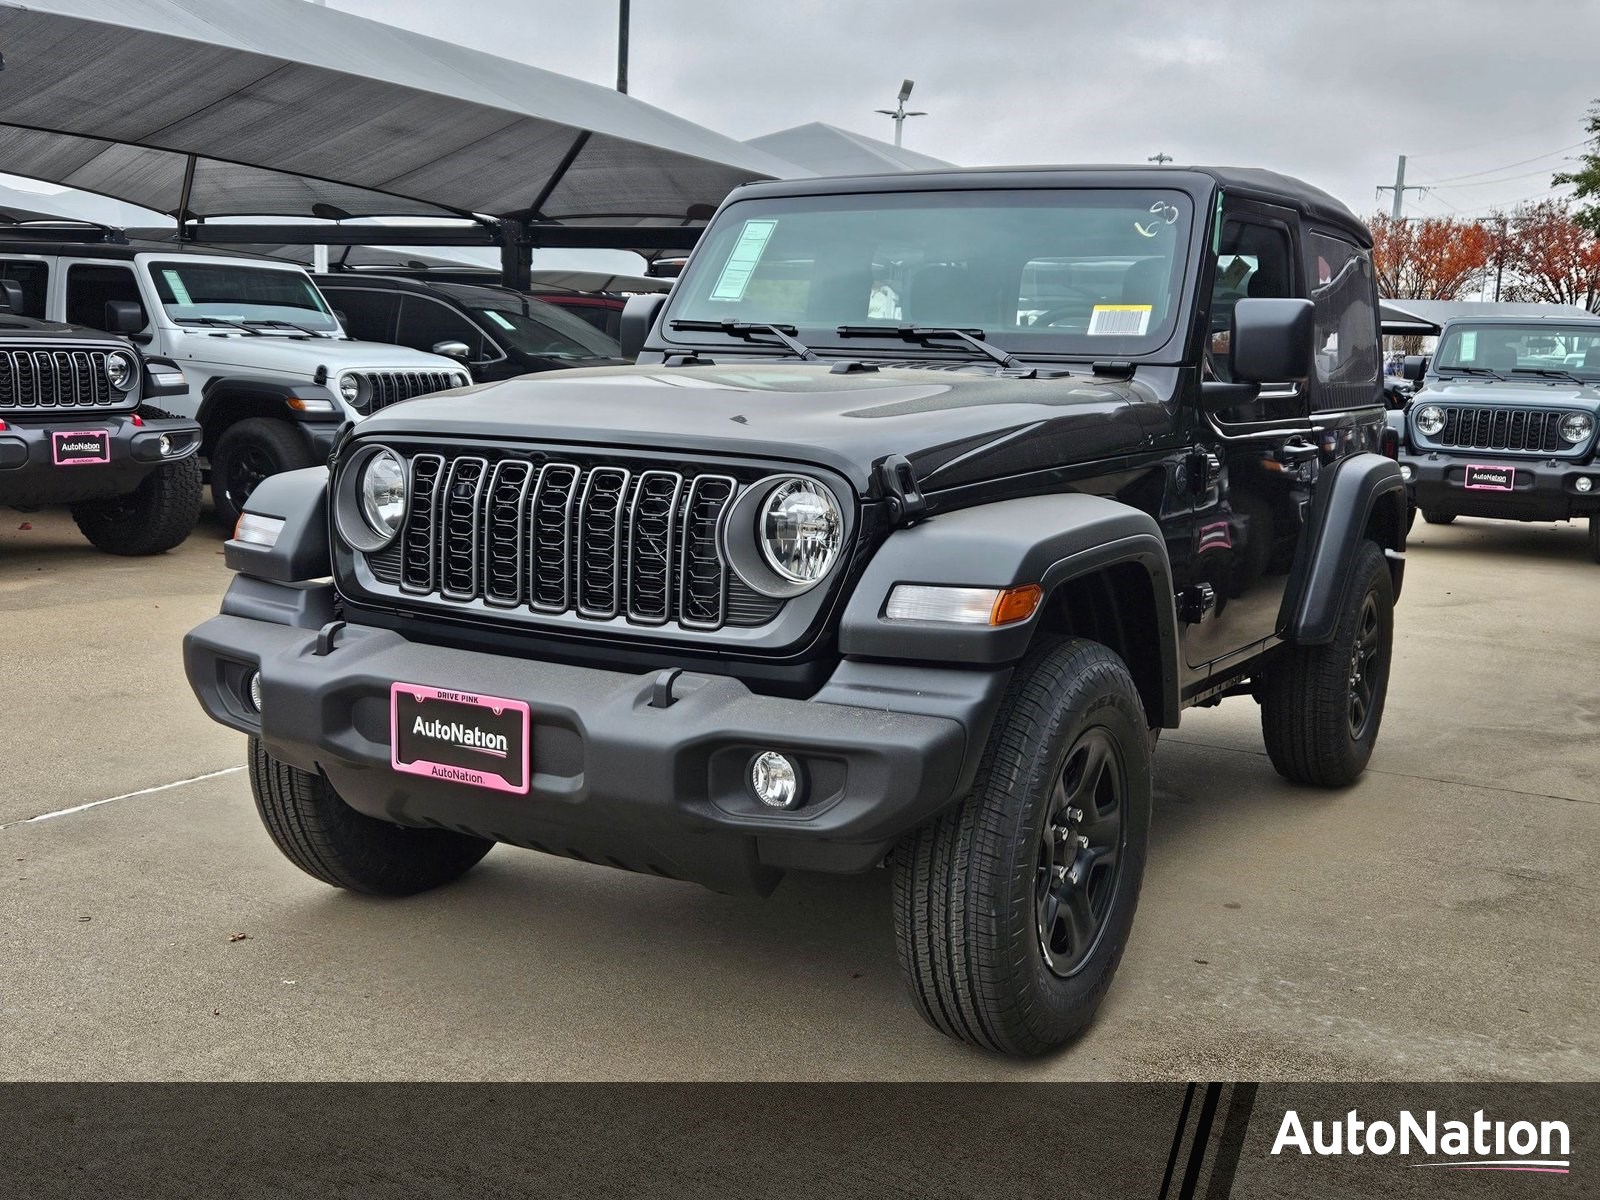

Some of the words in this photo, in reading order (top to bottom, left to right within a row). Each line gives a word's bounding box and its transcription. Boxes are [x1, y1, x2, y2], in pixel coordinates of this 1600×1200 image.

[61, 442, 100, 450] AutoNation
[437, 691, 459, 701] DRIVE
[461, 695, 479, 704] PINK
[412, 716, 507, 750] AutoNation
[431, 766, 484, 784] AutoNation
